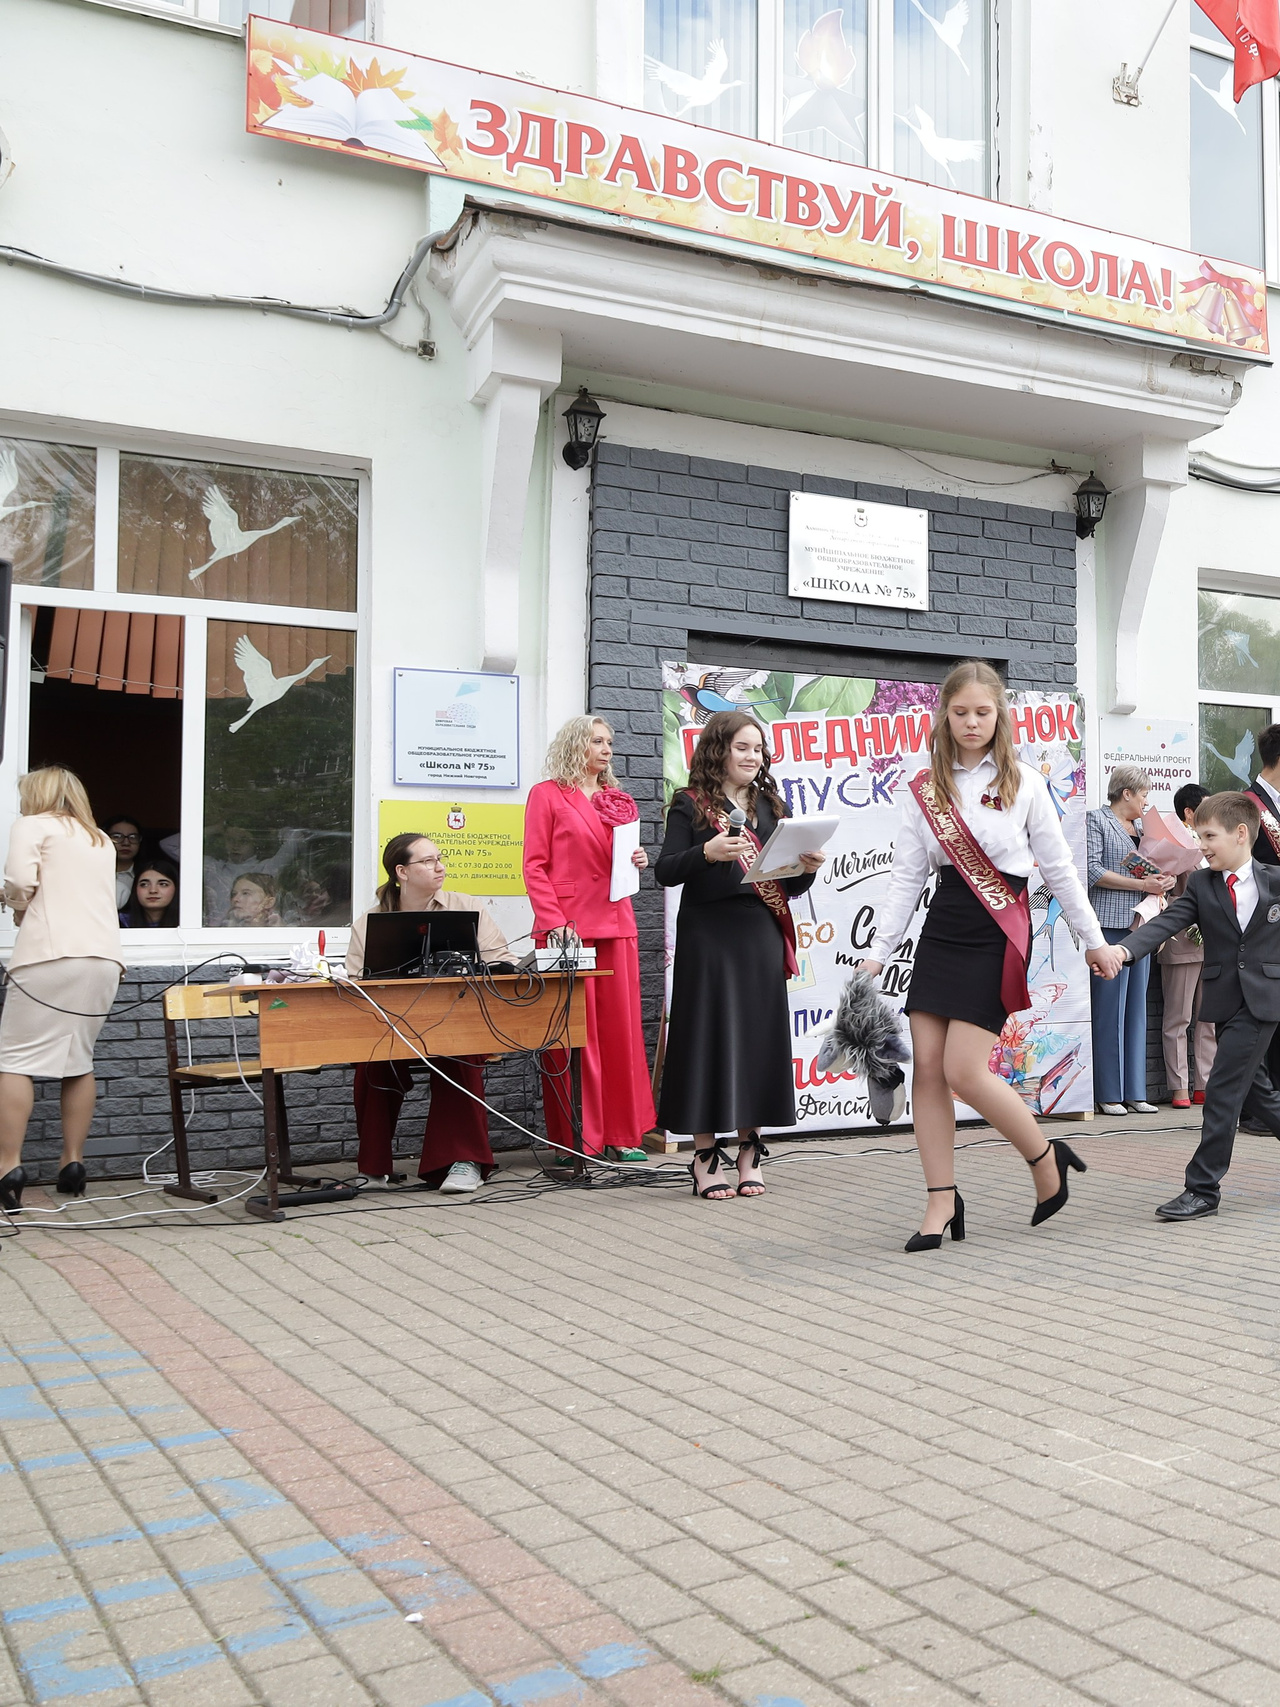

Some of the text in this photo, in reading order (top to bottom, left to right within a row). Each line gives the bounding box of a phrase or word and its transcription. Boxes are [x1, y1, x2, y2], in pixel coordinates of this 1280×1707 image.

[465, 99, 1175, 312] ЗДРАВСТВУЙ, ШКОЛА!
[804, 546, 916, 566] МУНИЦИПАЛЬНОЕ БЮДЖЕТНОЕ
[817, 555, 904, 571] ОБЩЕОБРАЗОВАТЕЛЬНОЕ
[836, 564, 885, 576] УЧРЕЖДЕНИЕ
[803, 576, 916, 599] «ШКОЛА № 75»
[1011, 703, 1080, 745] НОК
[419, 761, 496, 771] «Школа № 75»
[1103, 752, 1192, 764] ФЕДЕРАЛЬНЫЙ ПРОЕКТ
[782, 769, 897, 817] ПУСК
[969, 867, 1017, 911] 2025
